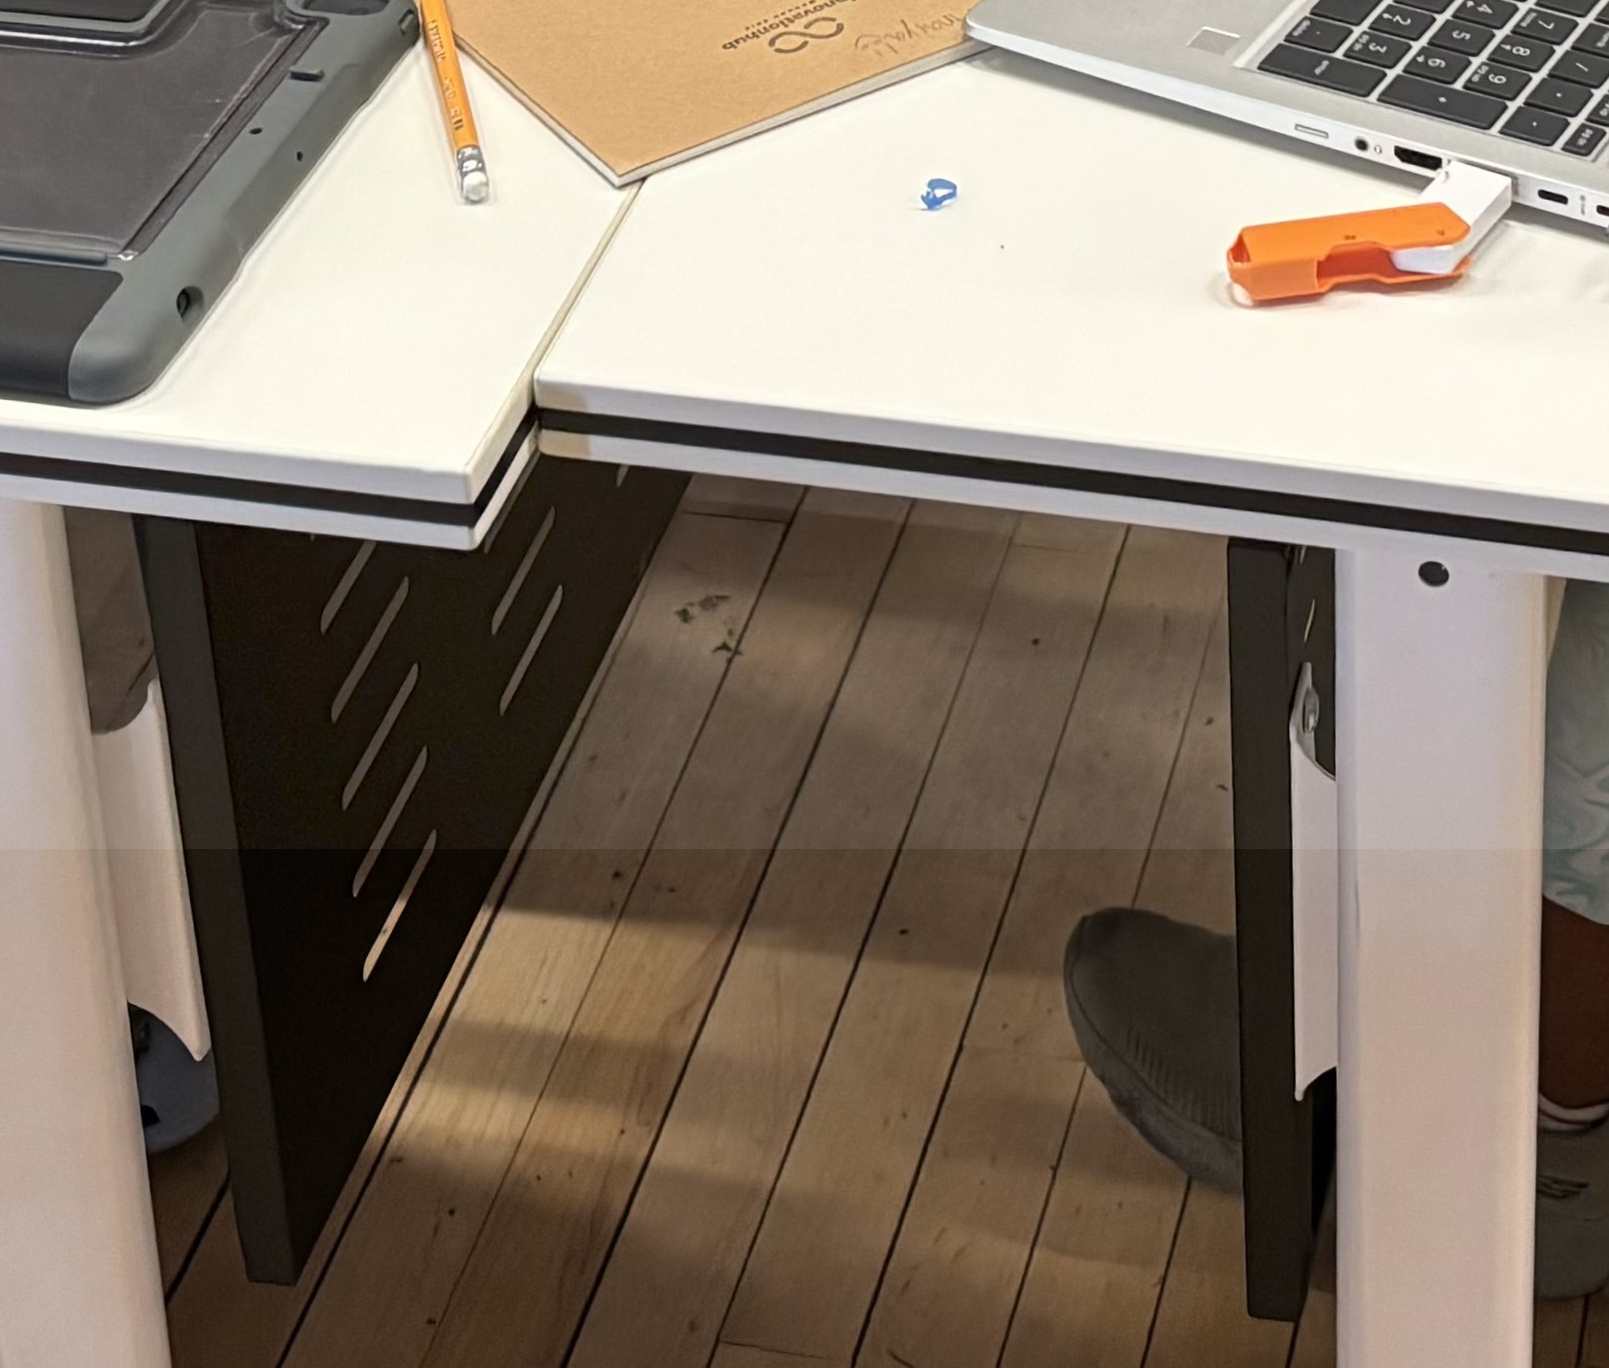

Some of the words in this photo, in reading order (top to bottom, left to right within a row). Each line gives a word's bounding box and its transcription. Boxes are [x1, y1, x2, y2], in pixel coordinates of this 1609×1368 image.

[1393, 13, 1412, 26] 2
[1537, 19, 1555, 30] 7
[1451, 29, 1472, 41] 5
[1368, 42, 1388, 54] 3
[1511, 45, 1531, 57] 8
[1427, 57, 1446, 68] 6
[1488, 73, 1507, 85] 9
